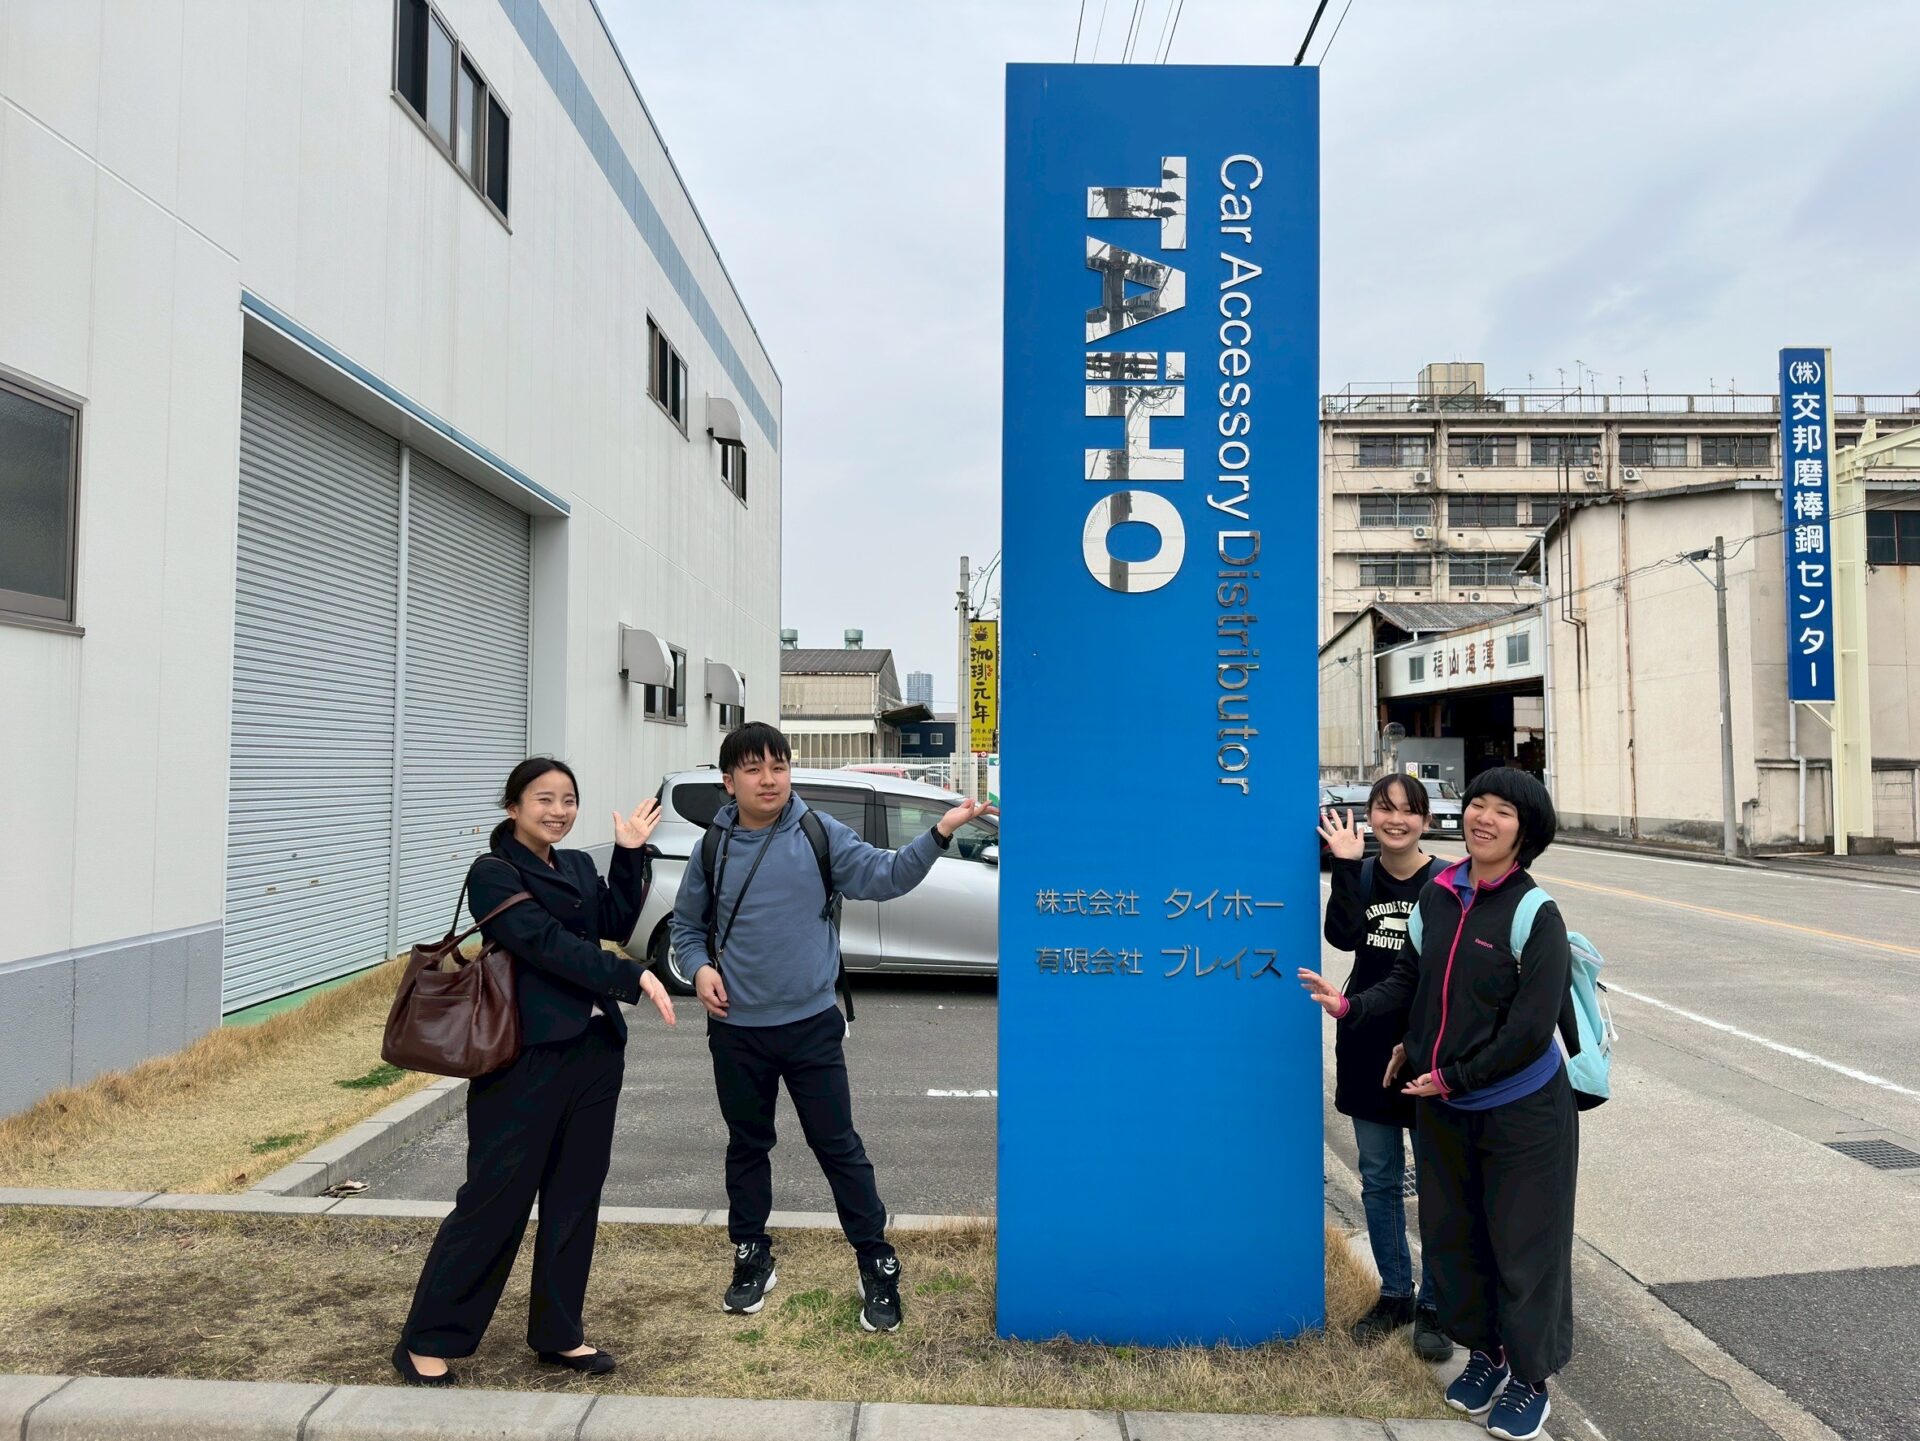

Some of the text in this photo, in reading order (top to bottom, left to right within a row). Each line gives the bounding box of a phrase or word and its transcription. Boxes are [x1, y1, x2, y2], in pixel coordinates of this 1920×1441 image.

[1207, 153, 1263, 796] Car Accessory Distributor
[970, 645, 993, 724] 珈琲元年
[1035, 887, 1285, 920] 株式会社 タイホー
[1365, 900, 1415, 921] RHODE ISL
[1366, 933, 1405, 951] PROVID
[1035, 944, 1283, 980] 有限会社 ブレイス
